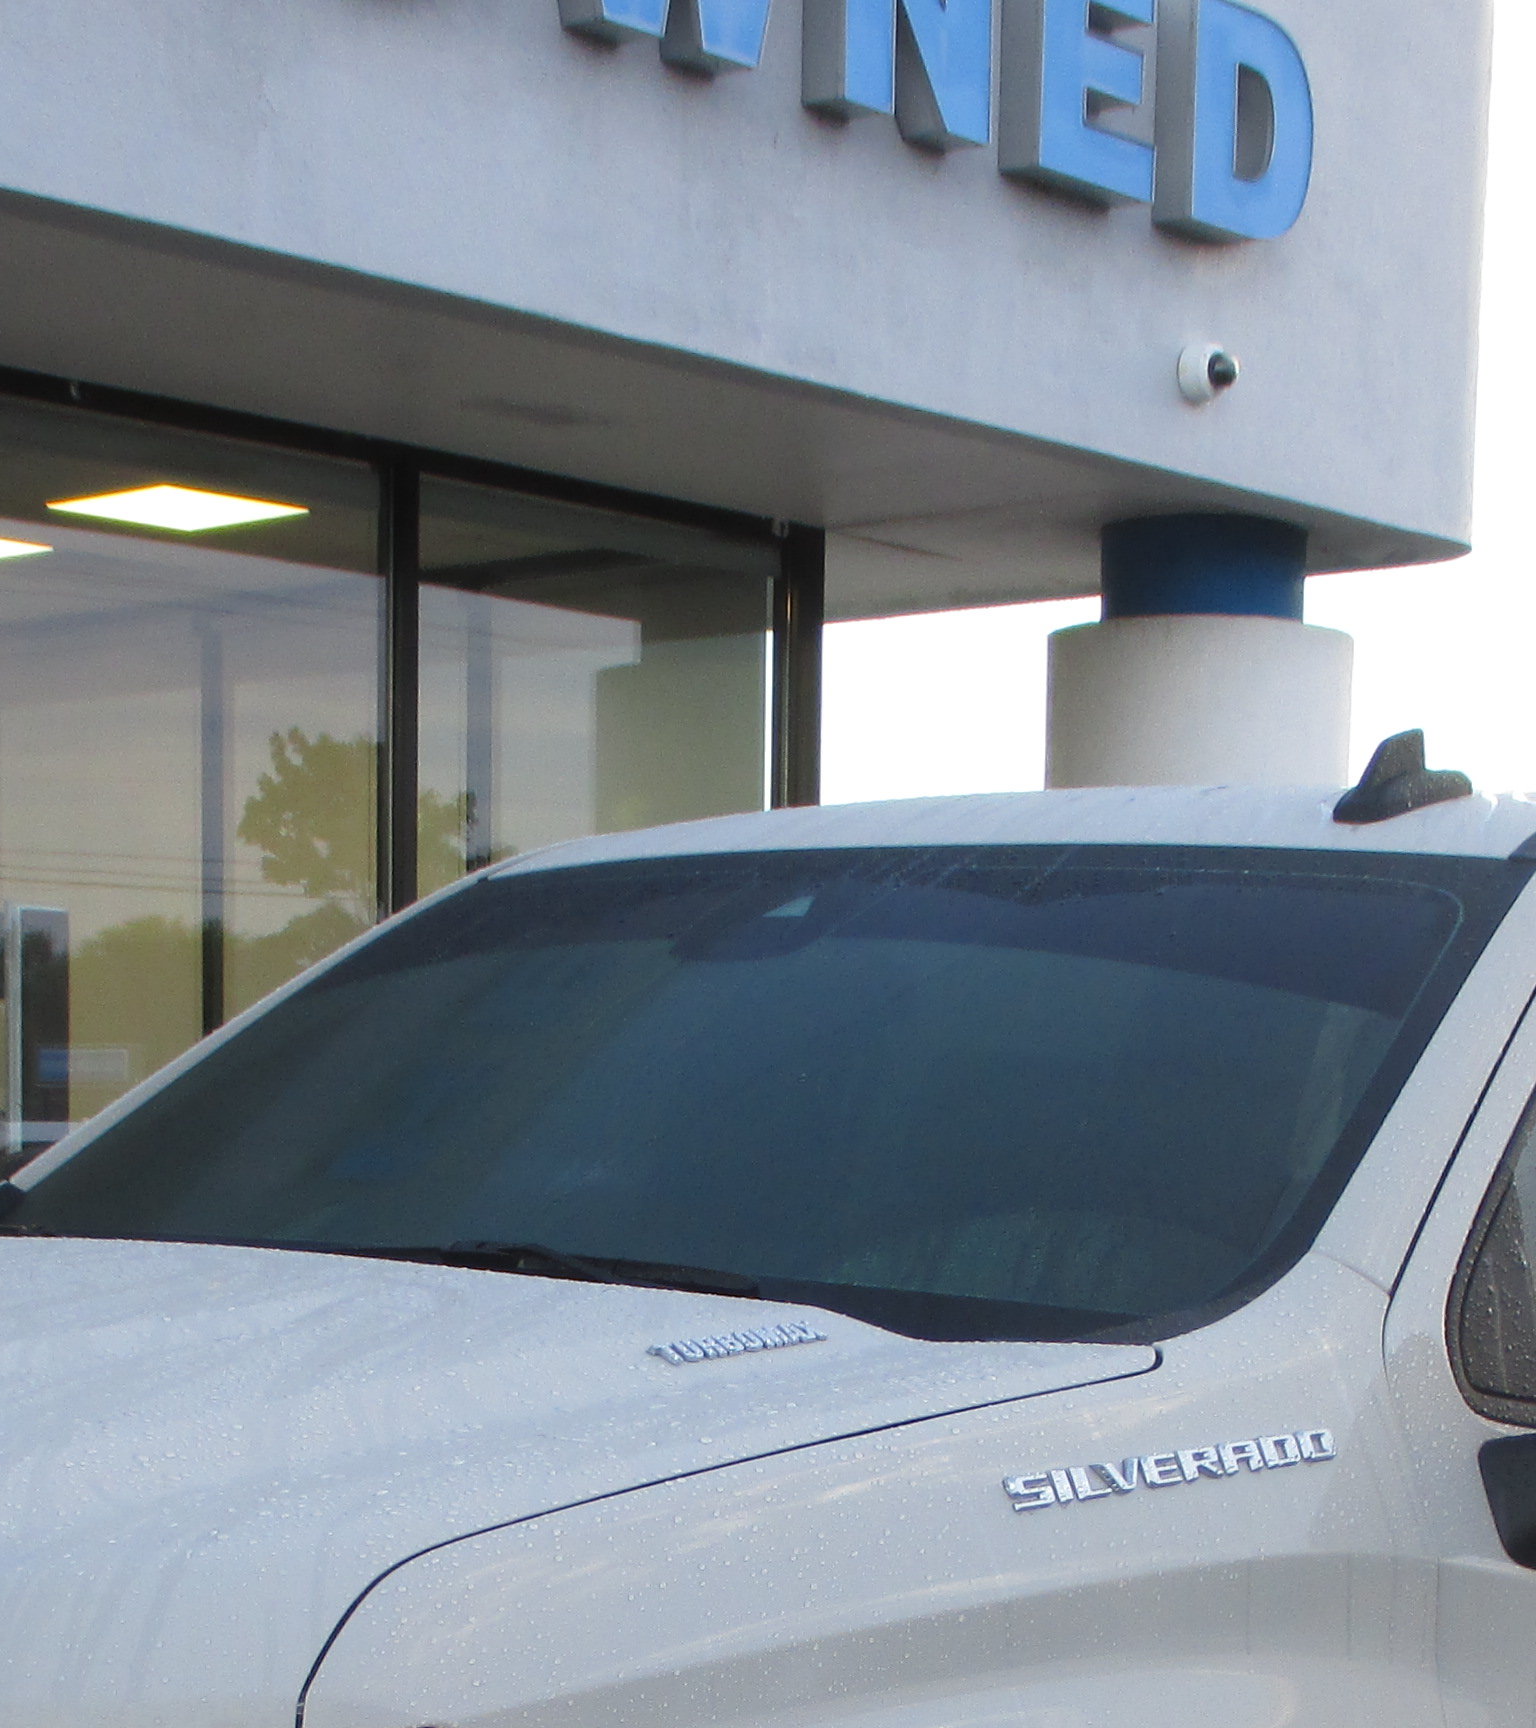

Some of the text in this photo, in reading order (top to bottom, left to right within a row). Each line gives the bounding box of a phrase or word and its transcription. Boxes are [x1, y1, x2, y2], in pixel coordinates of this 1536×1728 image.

[560, 0, 1314, 242] NED
[646, 1320, 828, 1367] TURBOMAX
[1001, 1429, 1337, 1511] SILVERADO
